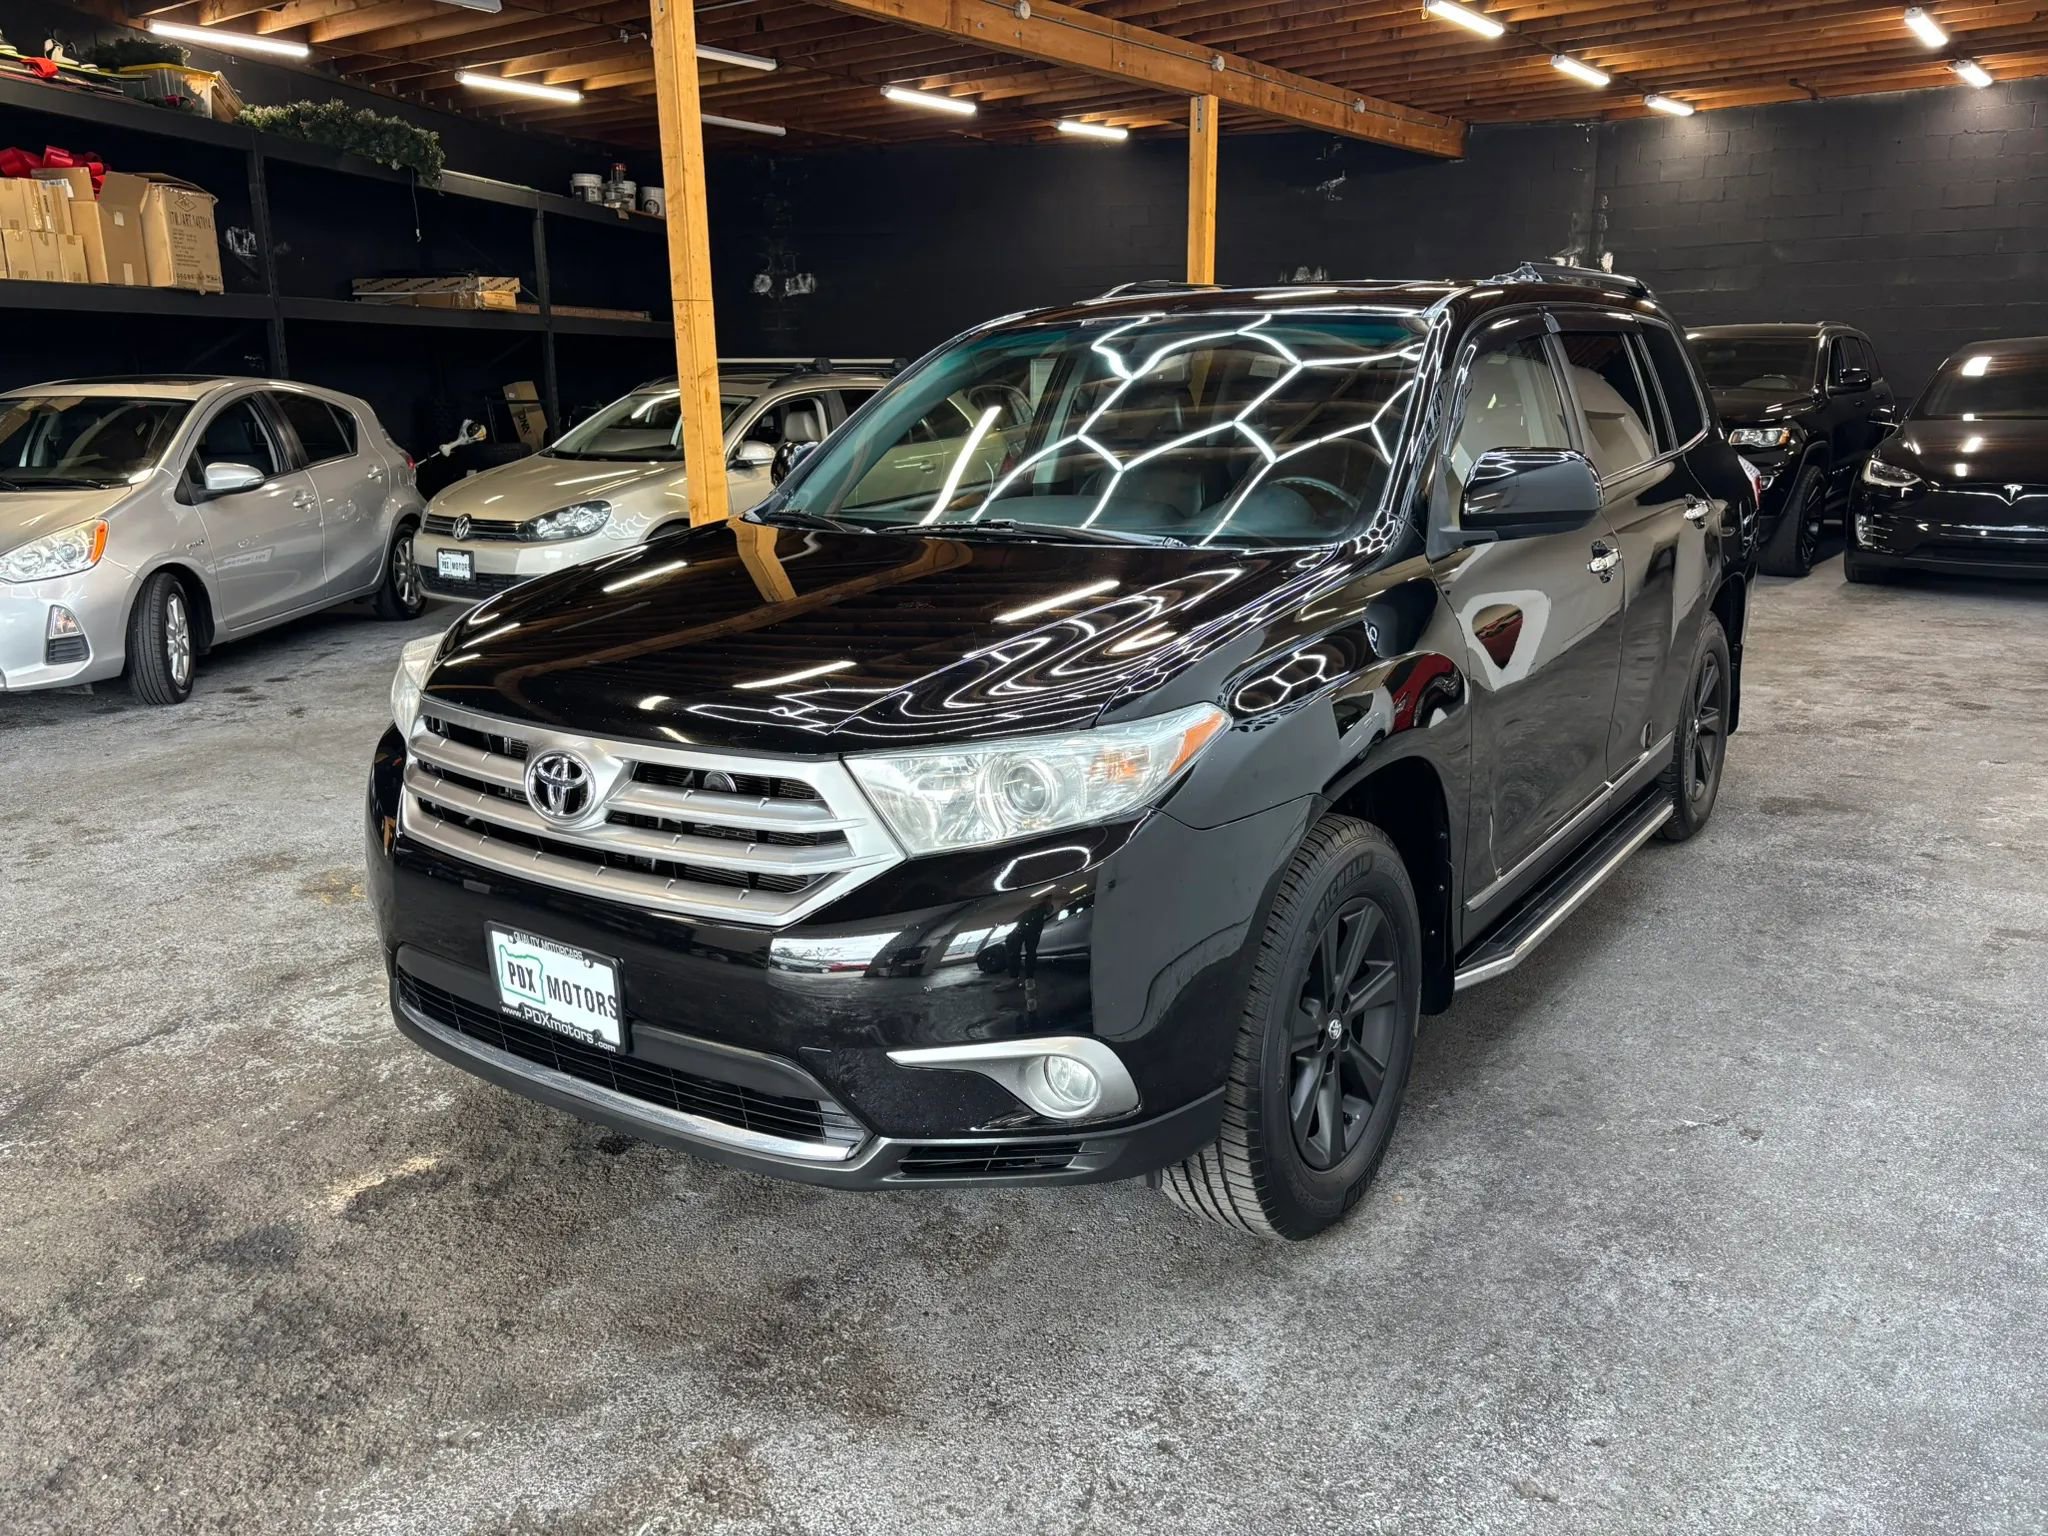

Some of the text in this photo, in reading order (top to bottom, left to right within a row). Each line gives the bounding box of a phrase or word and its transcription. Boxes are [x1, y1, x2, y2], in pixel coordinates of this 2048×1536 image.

[513, 931, 584, 961] QUALITY MOTORCARS
[507, 960, 618, 1020] PDX MOTORS
[501, 1005, 616, 1053] www.PDXmotors.com
